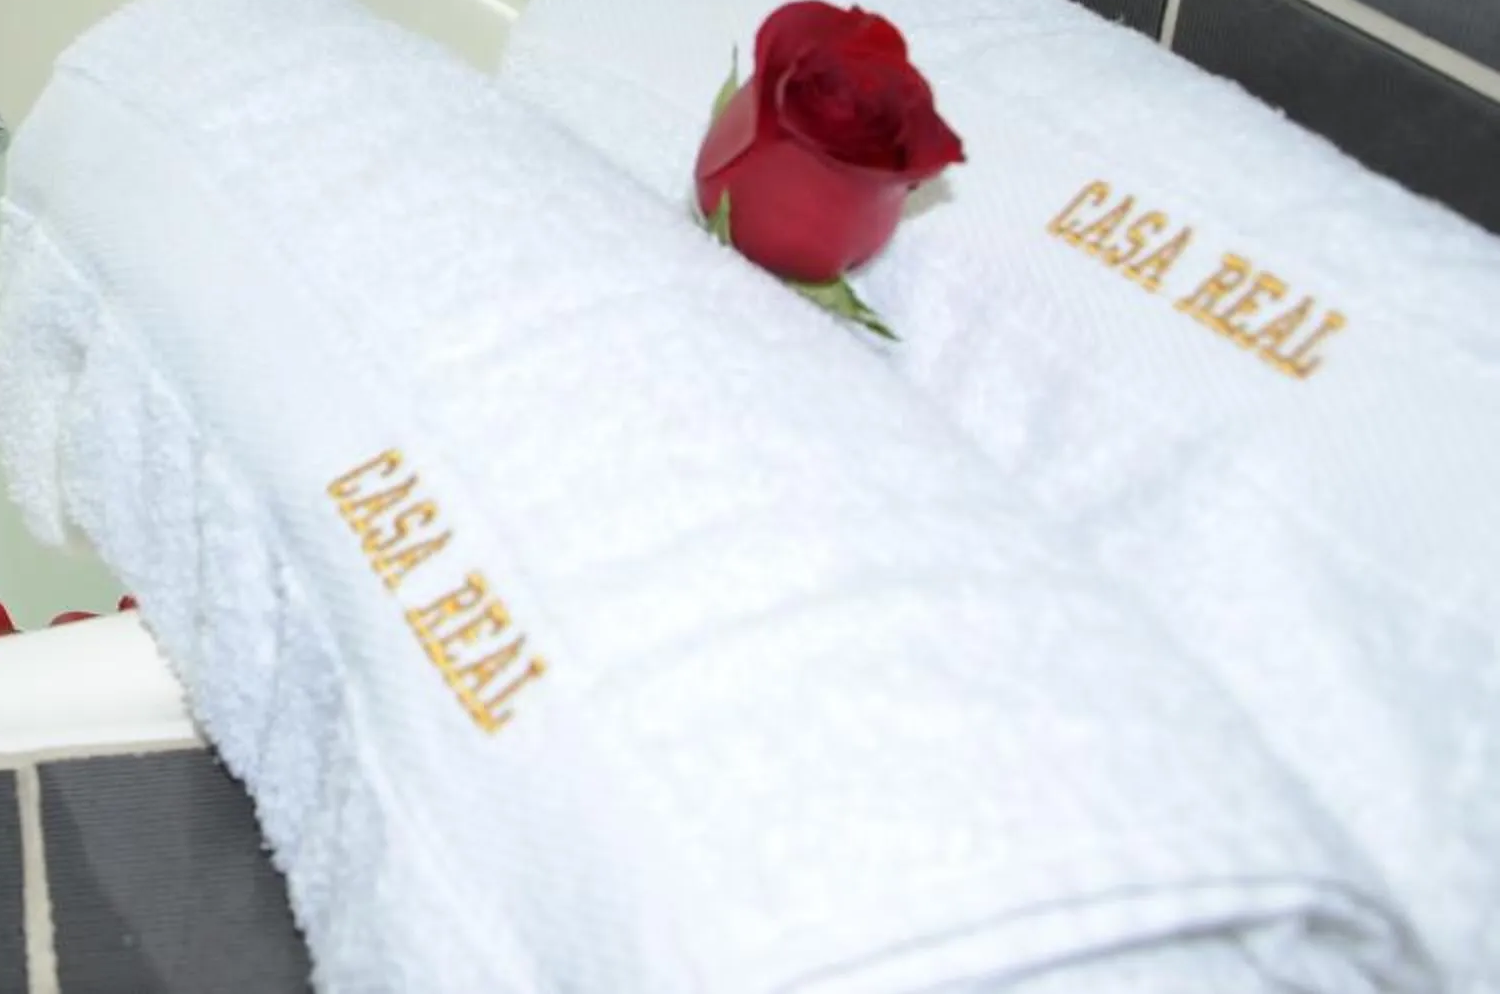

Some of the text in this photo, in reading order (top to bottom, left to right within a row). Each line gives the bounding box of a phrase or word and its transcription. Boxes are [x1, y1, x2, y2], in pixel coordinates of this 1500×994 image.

[1047, 180, 1347, 380] CASA REAL
[327, 449, 546, 733] CASA REAL
